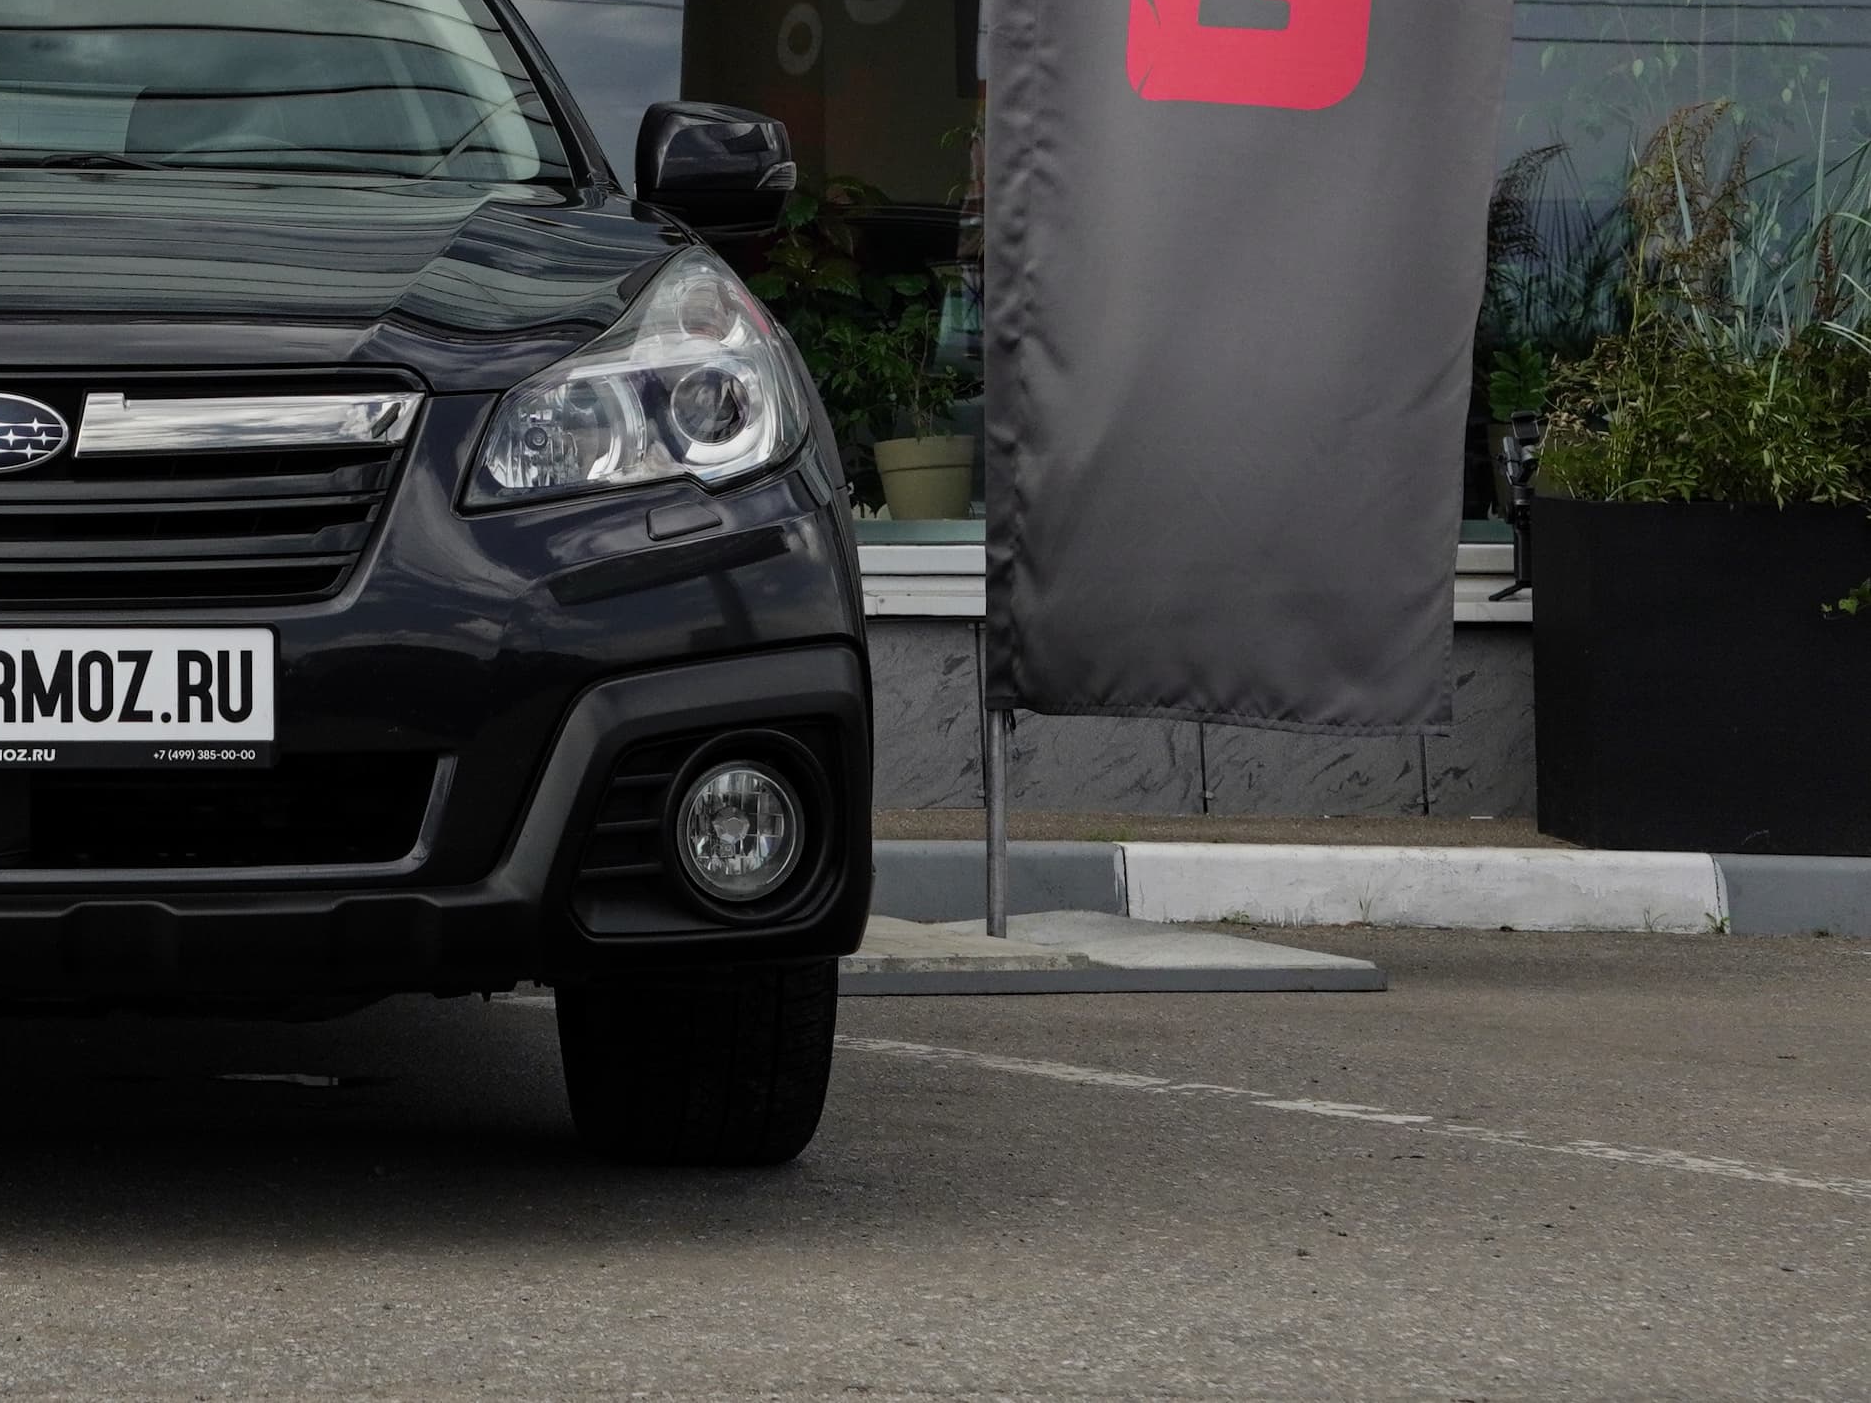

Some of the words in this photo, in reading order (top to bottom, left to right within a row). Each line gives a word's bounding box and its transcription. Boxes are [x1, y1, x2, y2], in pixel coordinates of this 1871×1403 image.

[153, 749, 166, 760] +7
[168, 749, 195, 761] (499)
[197, 749, 256, 760] 385-00-00
